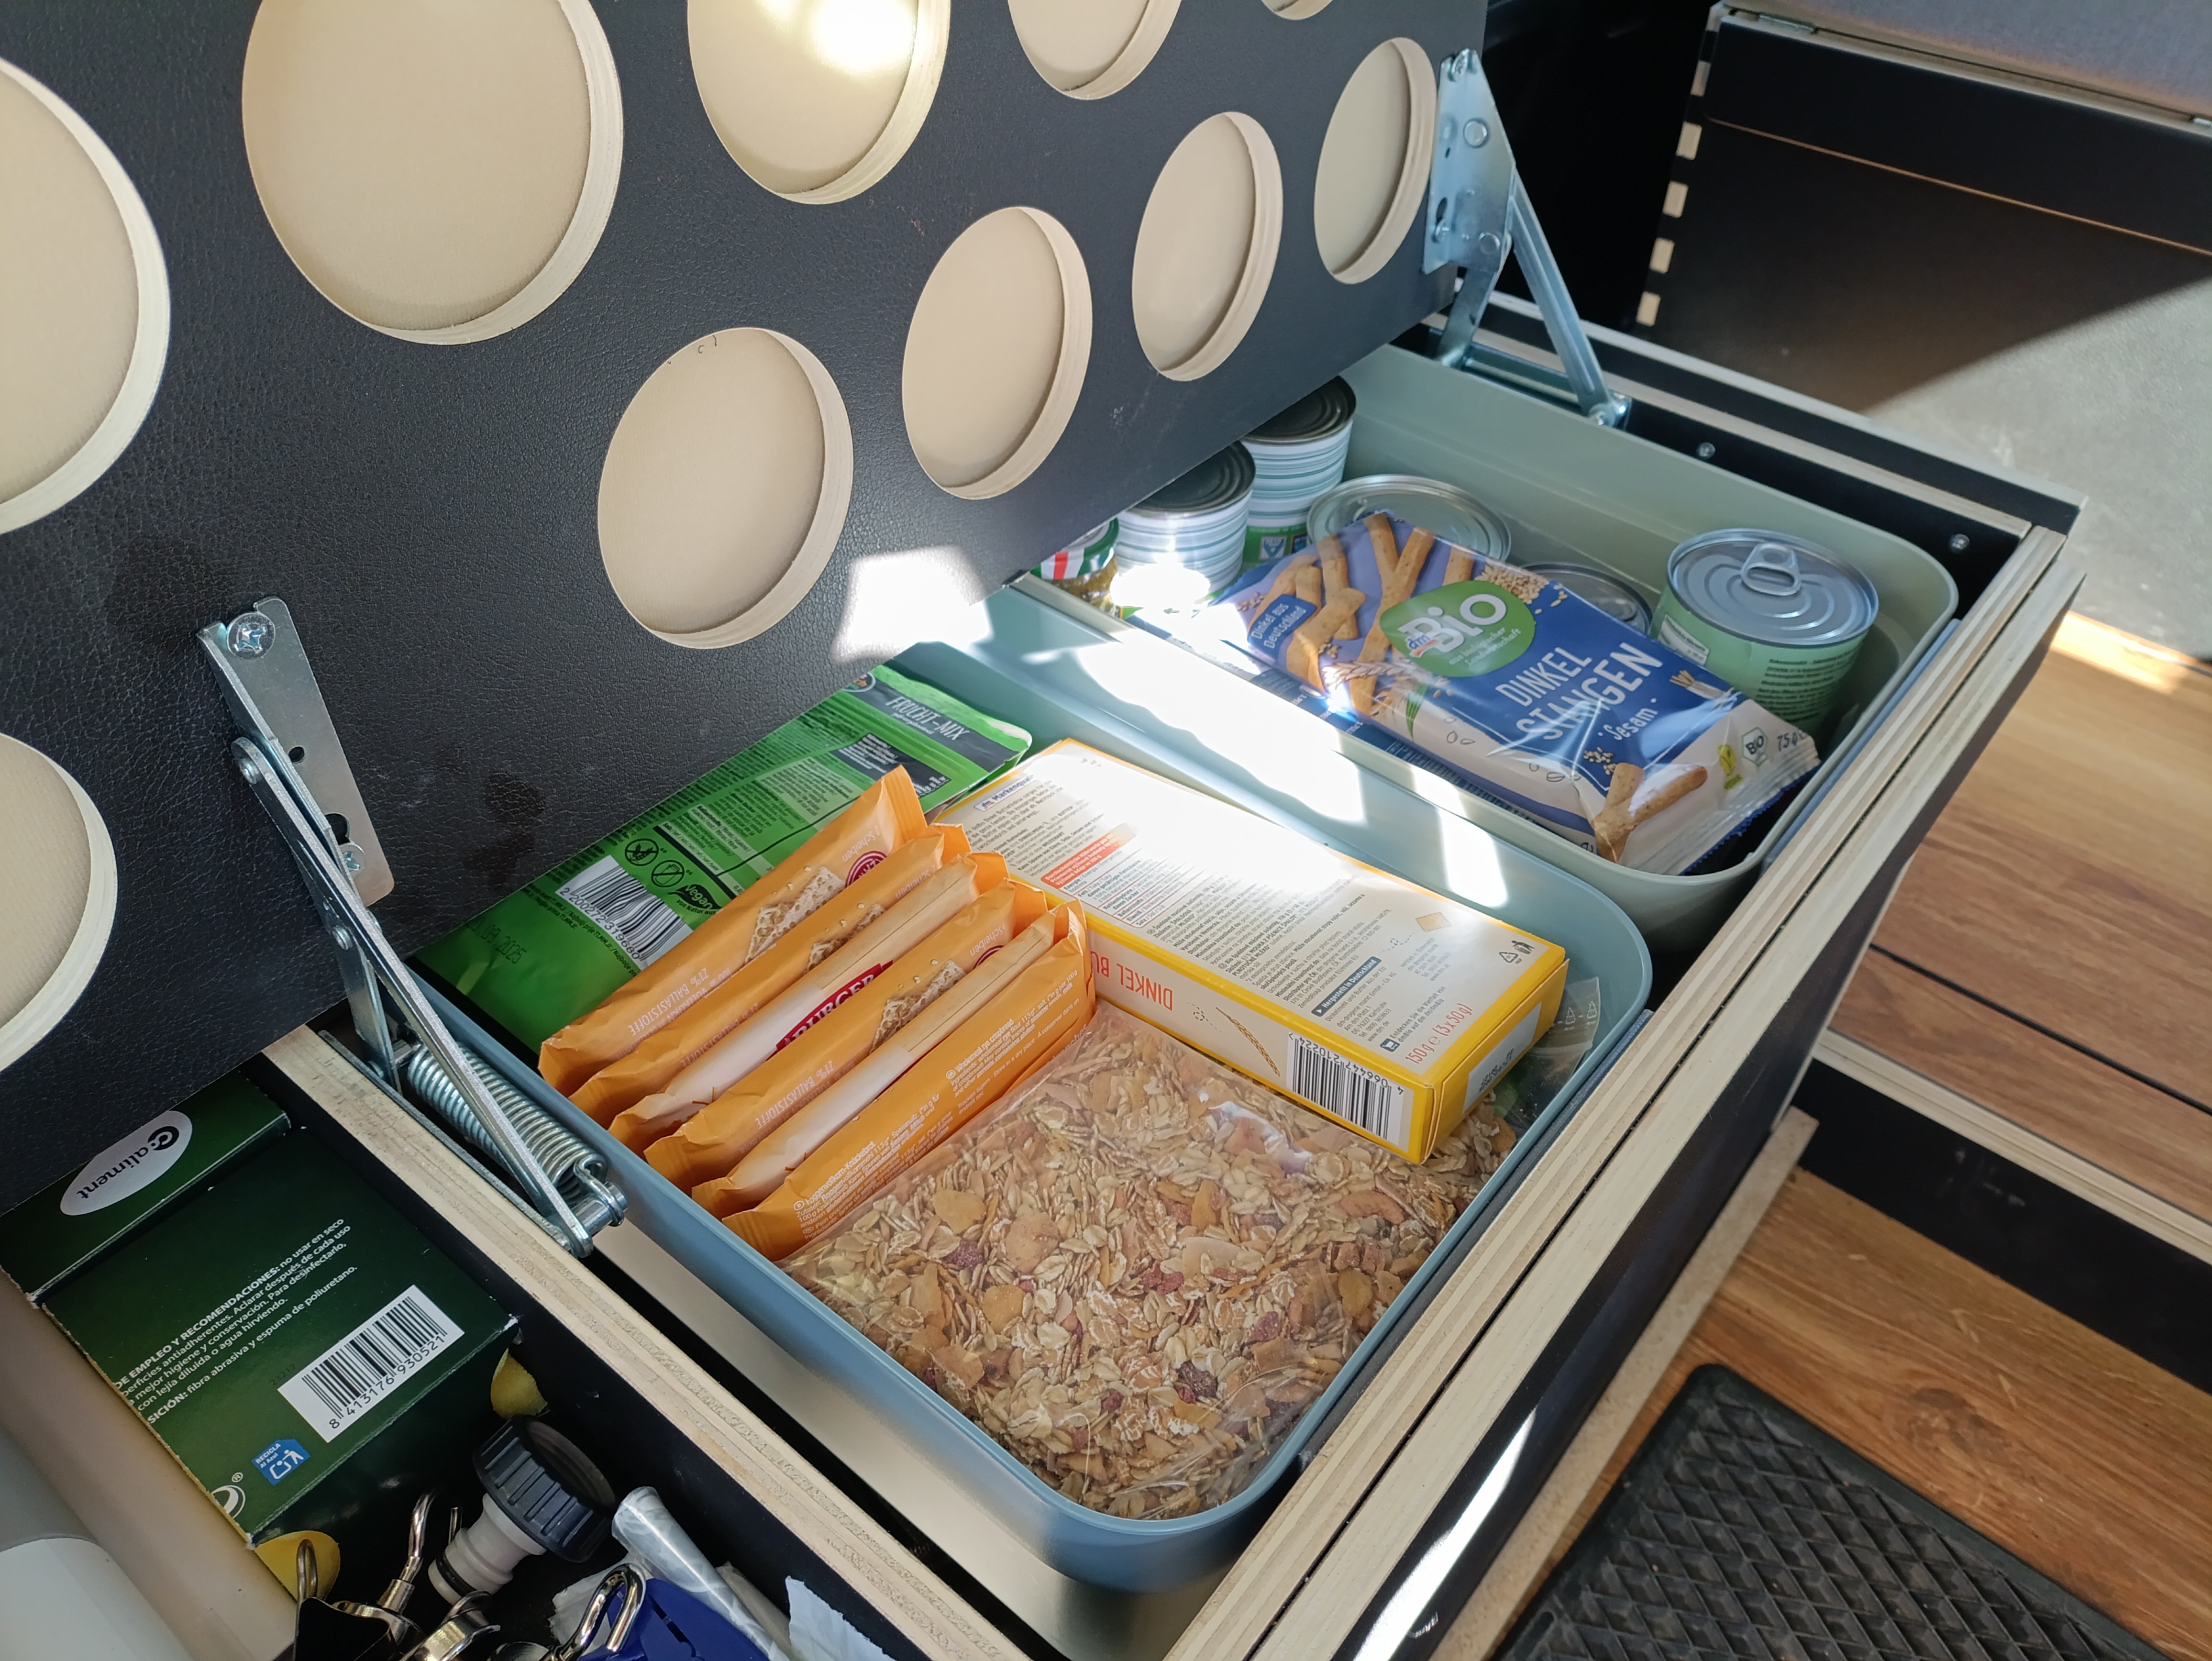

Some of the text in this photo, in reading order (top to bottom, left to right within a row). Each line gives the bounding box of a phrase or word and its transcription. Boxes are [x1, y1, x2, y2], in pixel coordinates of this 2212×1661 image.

[1251, 603, 1289, 639] Dinkel aus
[1264, 607, 1306, 649] Deutschland
[1495, 647, 1592, 707] DINKEL
[1516, 642, 1662, 740] STANGEN
[885, 697, 970, 741] FRUCHT-MIX
[1604, 708, 1658, 740] Sesam
[1746, 736, 1764, 754] BIO
[840, 830, 876, 865] Scheiben
[676, 900, 687, 908] von
[686, 905, 704, 915] Natur
[686, 885, 713, 908] Vegan
[560, 887, 570, 896] 2
[569, 894, 606, 923] 200272
[605, 922, 640, 960] 319680
[968, 925, 1004, 958] Scheiben
[1116, 963, 1173, 1011] DINKEL
[1320, 986, 1350, 1009] Hergestellt
[1347, 958, 1378, 983] Deutschland
[627, 981, 690, 1039] BALLASTSTOFFE
[1041, 1013, 1063, 1035] conserver
[1335, 1005, 1363, 1027] dm-drogerie
[1344, 1023, 1354, 1031] Am
[1349, 1008, 1371, 1025] dm-Platz
[1349, 1000, 1389, 1034] DE-76227 Karlsruhe
[1388, 985, 1447, 1039] Entdecken Sie die Vielfalt von
[1396, 1028, 1415, 1043] dmBio
[1409, 1021, 1420, 1030] auf
[954, 1045, 983, 1074] Wholemeal
[988, 1017, 1015, 1044] crispbread
[1299, 1037, 1404, 1095] 4 066447 210224
[754, 1074, 815, 1131] BALLASTSTOFFE
[128, 1343, 173, 1379] EMPLEO
[170, 1337, 181, 1347] Y
[179, 1264, 281, 1340] RECOMENDACIONES:
[279, 1256, 294, 1269] no
[291, 1241, 312, 1259] usar
[310, 1232, 325, 1245] en
[322, 1217, 345, 1236] seco
[160, 1310, 234, 1368] antiadherentes.
[231, 1287, 265, 1315] Aclarar
[262, 1260, 303, 1293] después
[299, 1251, 314, 1264] de
[311, 1235, 335, 1255] cada
[333, 1224, 352, 1240] uso
[133, 1374, 166, 1401] mejor
[162, 1347, 203, 1379] higiene
[199, 1343, 210, 1353] y
[207, 1296, 270, 1346] conservación.
[266, 1281, 290, 1301] Para
[287, 1238, 348, 1286] desinfectarlo,
[136, 1295, 288, 1412] con lejía diluida o agua hirviendo.
[145, 1262, 359, 1424] SICIÓN: fibra abrasiva y espuma de poliuretano.
[329, 1335, 445, 1429] 8 413176 930521
[255, 1443, 281, 1464] RECICLA
[266, 1452, 278, 1464] Azul
